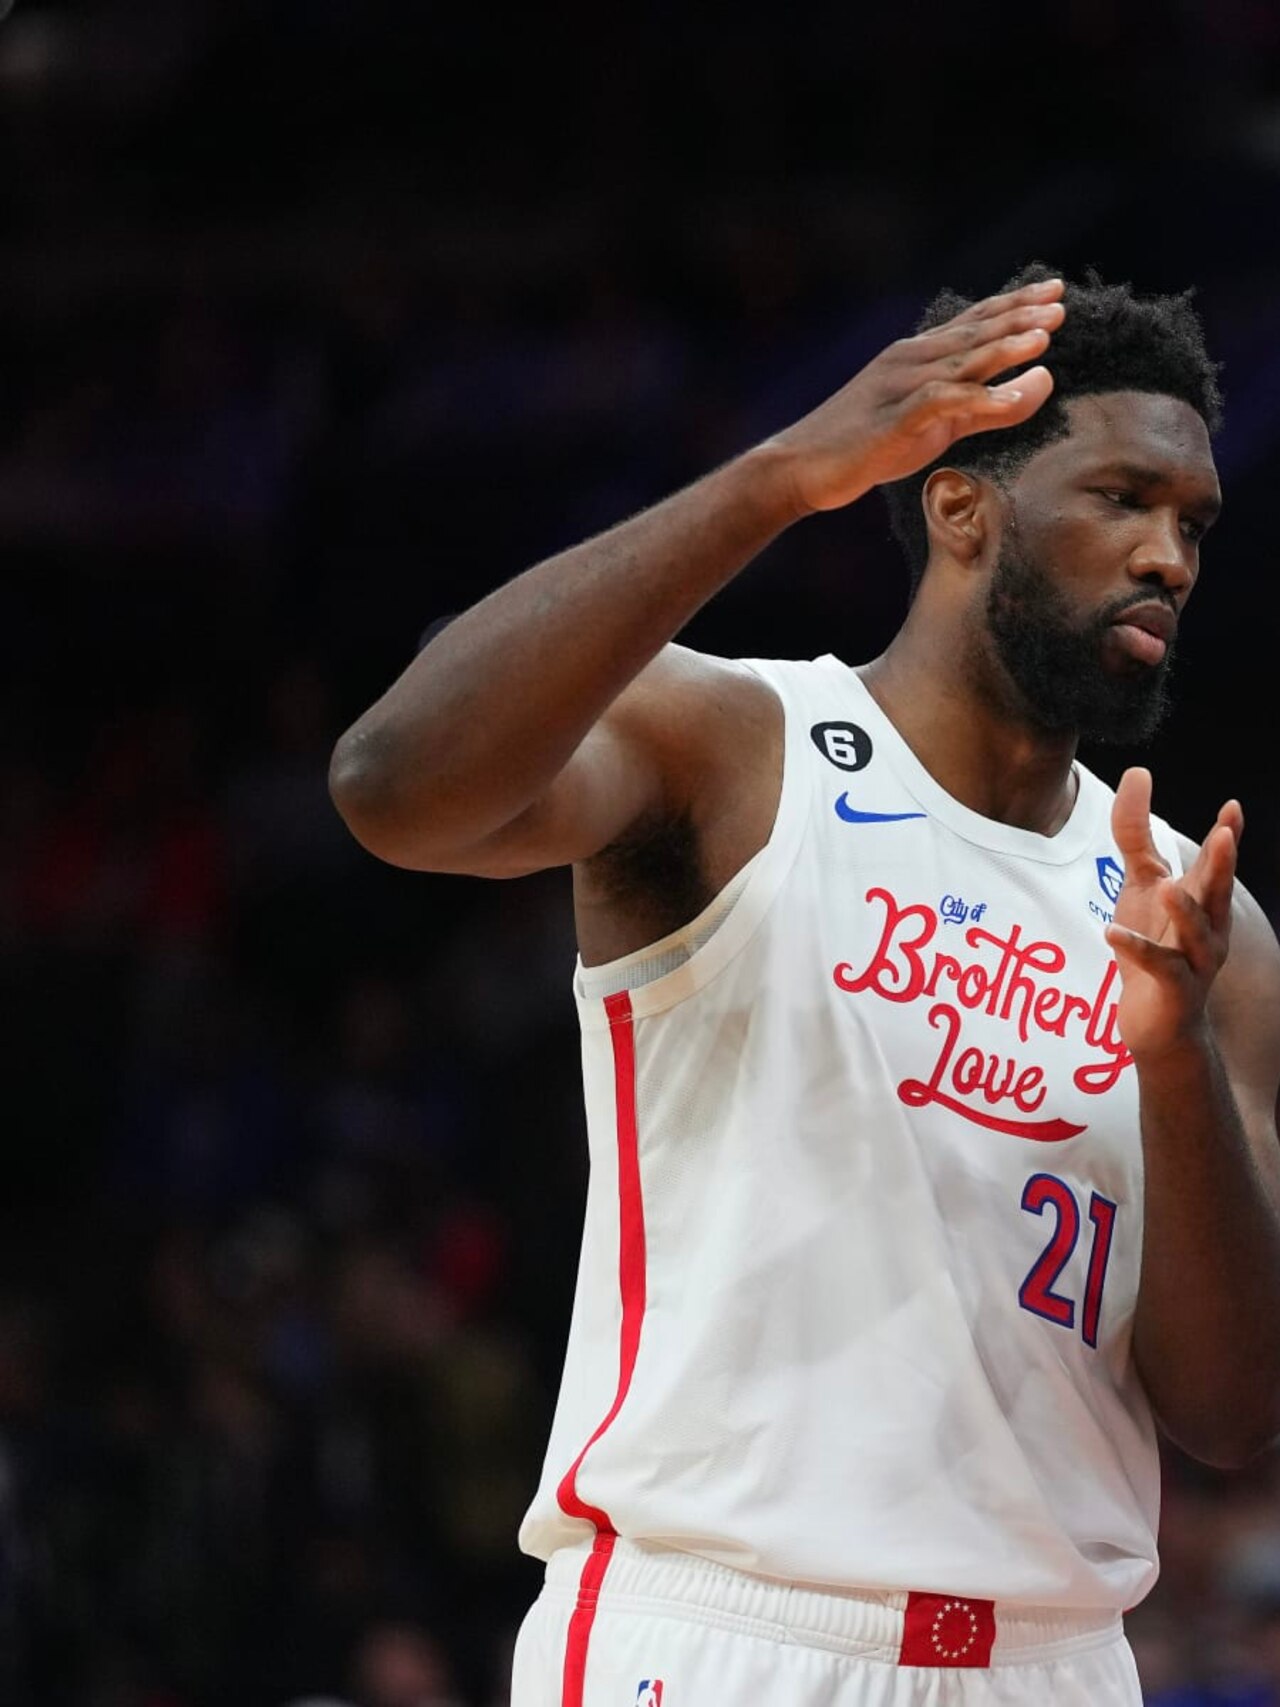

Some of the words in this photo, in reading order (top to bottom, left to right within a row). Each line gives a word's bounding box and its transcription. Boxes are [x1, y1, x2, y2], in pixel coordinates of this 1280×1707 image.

[823, 729, 857, 766] 6
[940, 895, 969, 925] City
[971, 903, 987, 922] of
[833, 887, 1136, 1094] Brotherly
[897, 1003, 1088, 1142] Love
[1018, 1173, 1118, 1349] 21
